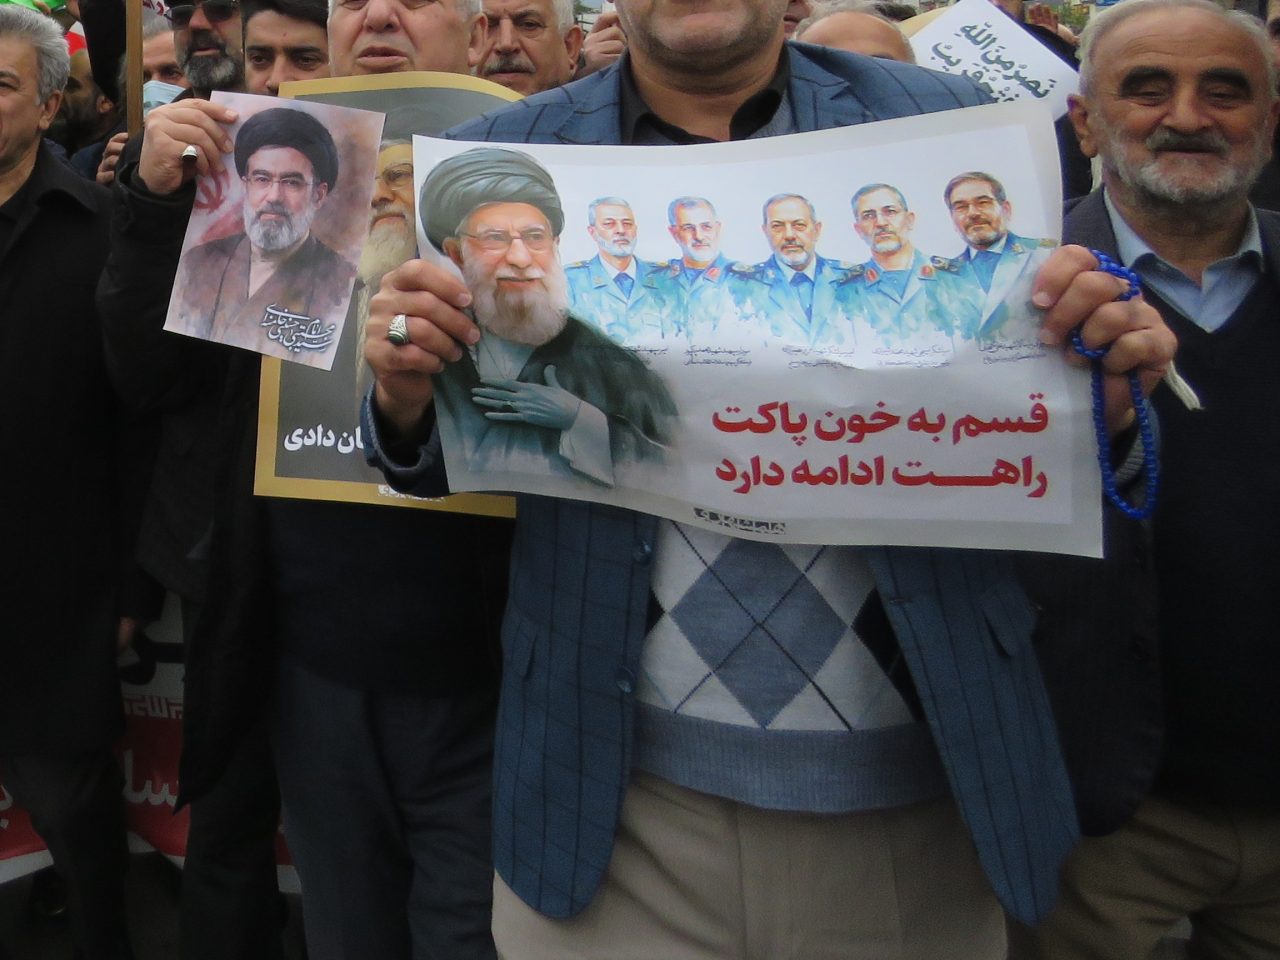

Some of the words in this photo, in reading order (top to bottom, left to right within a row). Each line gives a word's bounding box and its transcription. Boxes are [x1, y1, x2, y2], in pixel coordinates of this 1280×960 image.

[284, 424, 336, 451] دادی
[711, 401, 808, 446] پاکت
[813, 401, 901, 443] خون
[907, 406, 947, 443] به
[952, 392, 1050, 445] قسم
[715, 455, 785, 494] دارد
[791, 454, 885, 487] ادامه
